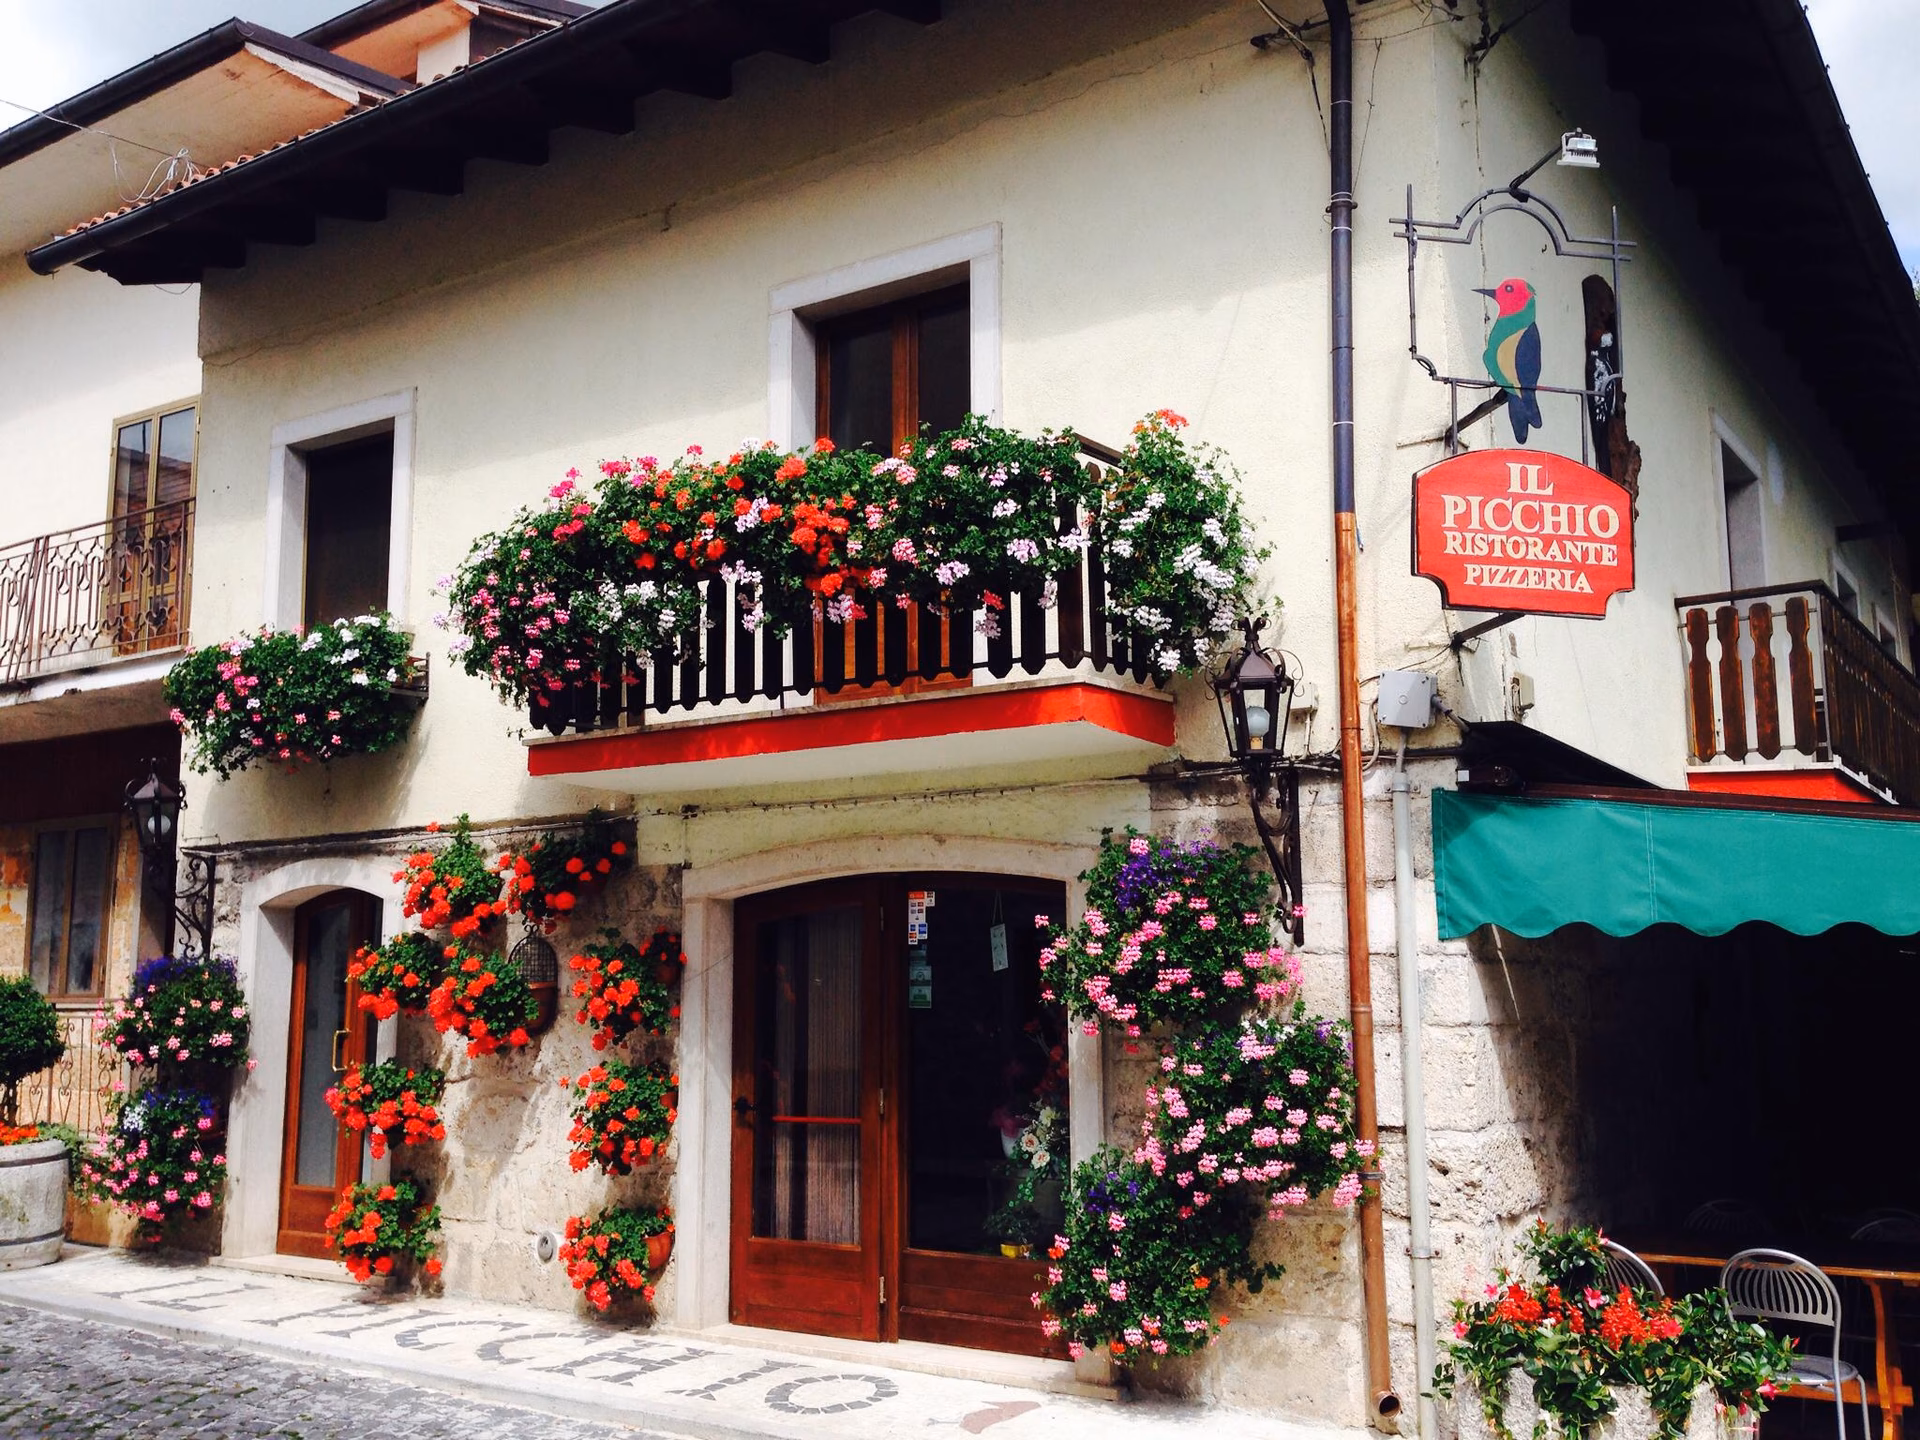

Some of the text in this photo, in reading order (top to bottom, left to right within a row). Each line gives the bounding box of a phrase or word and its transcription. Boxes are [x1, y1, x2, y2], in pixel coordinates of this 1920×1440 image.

[1505, 462, 1554, 496] IL
[1441, 494, 1620, 539] PICCHIO
[1443, 530, 1618, 567] RISTORANTE
[1464, 563, 1594, 594] PIZZERIA
[94, 1276, 900, 1416] IL PICCHIO
